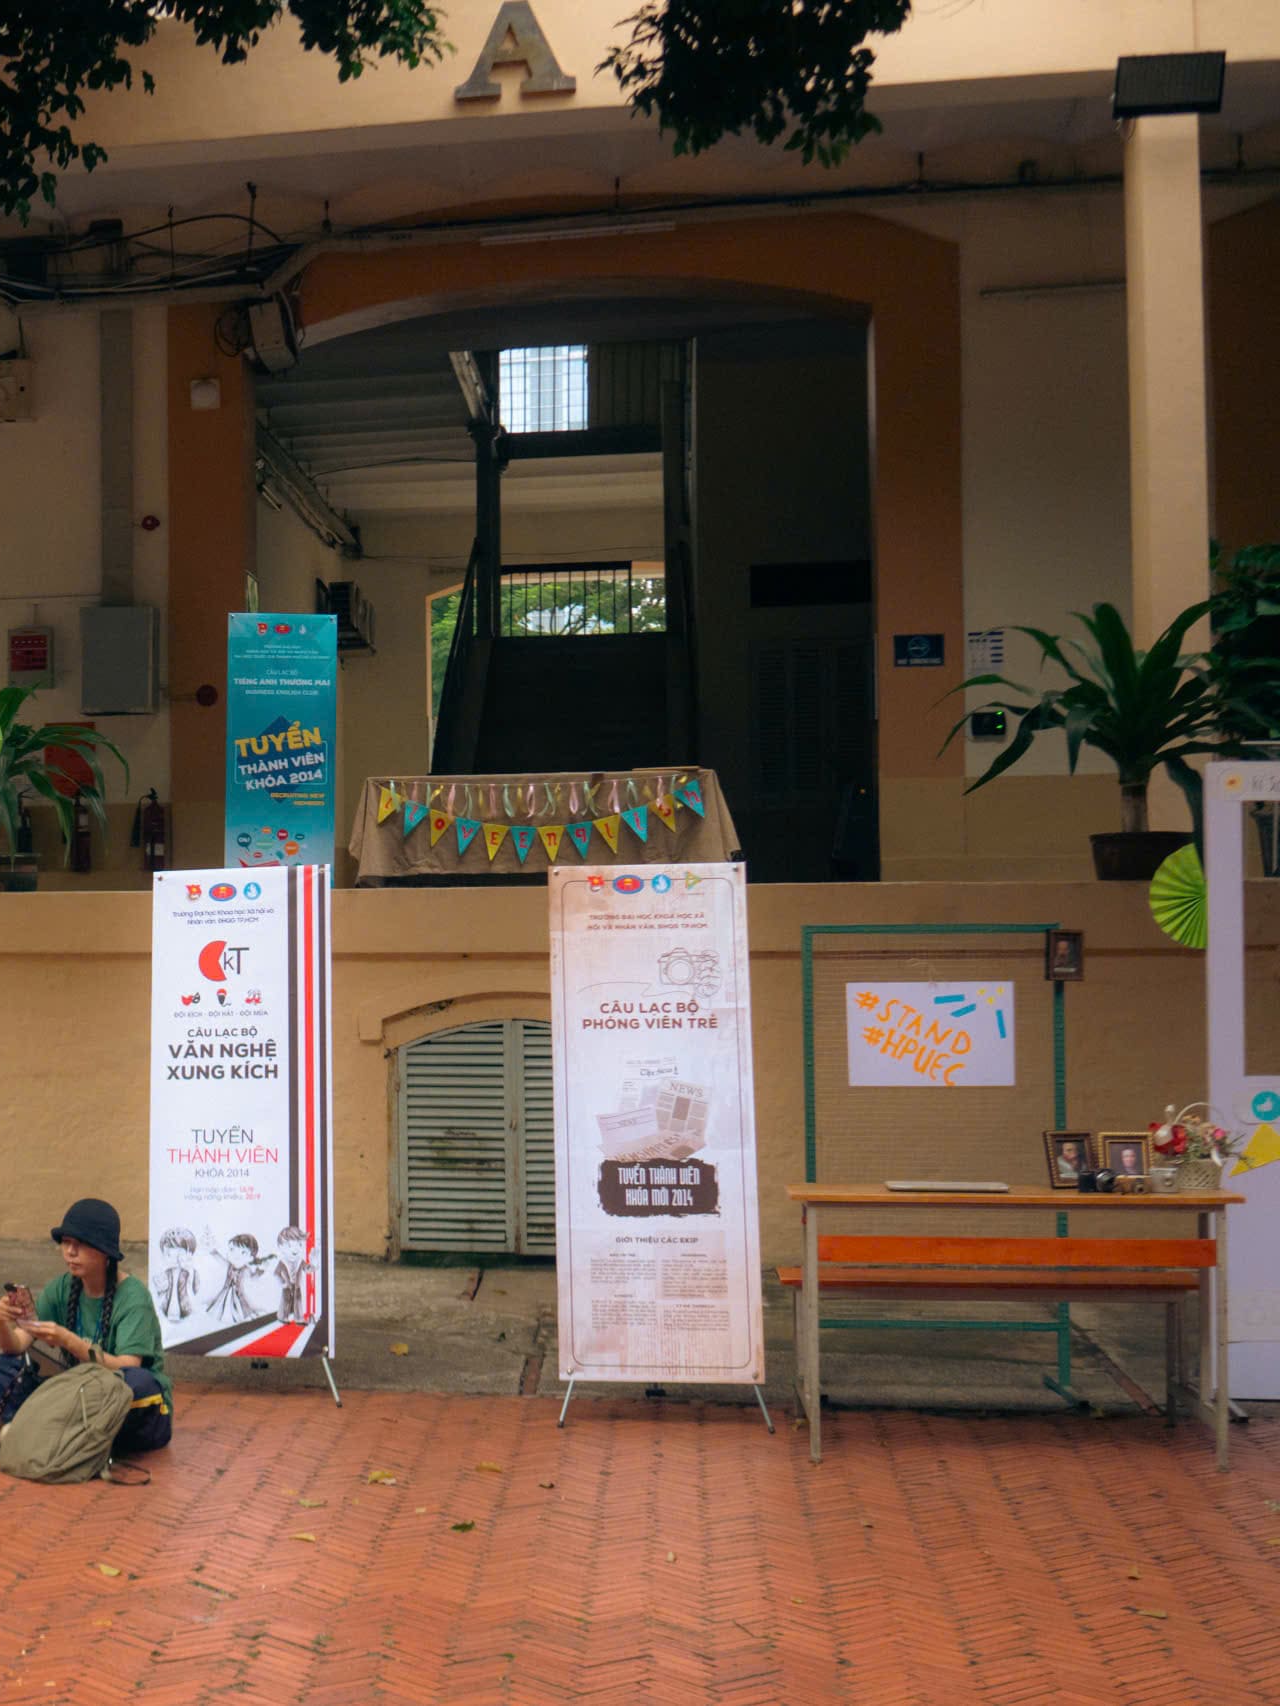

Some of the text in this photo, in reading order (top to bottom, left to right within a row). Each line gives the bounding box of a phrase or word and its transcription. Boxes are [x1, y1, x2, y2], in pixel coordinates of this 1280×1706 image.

[455, 1, 576, 102] A
[235, 721, 322, 758] TUYỂN
[239, 752, 325, 776] THÀNH VIÊN
[246, 769, 323, 791] KHÓA 2014
[600, 1000, 700, 1016] CÂU LẠC BỘ
[582, 1013, 719, 1030] PHÓNG VIÊN TRẺ
[854, 991, 972, 1055] #STAND
[187, 1026, 258, 1039] CÂU LẠC BỘ
[168, 1039, 277, 1062] VĂN NGHỆ
[167, 1061, 279, 1081] XUNG KÍCH
[669, 1081, 705, 1098] NEWS
[192, 1125, 254, 1144] TUYỂN
[167, 1145, 279, 1164] THÀNH VIÊN
[227, 1168, 250, 1178] 2014
[672, 1188, 694, 1206] 2014
